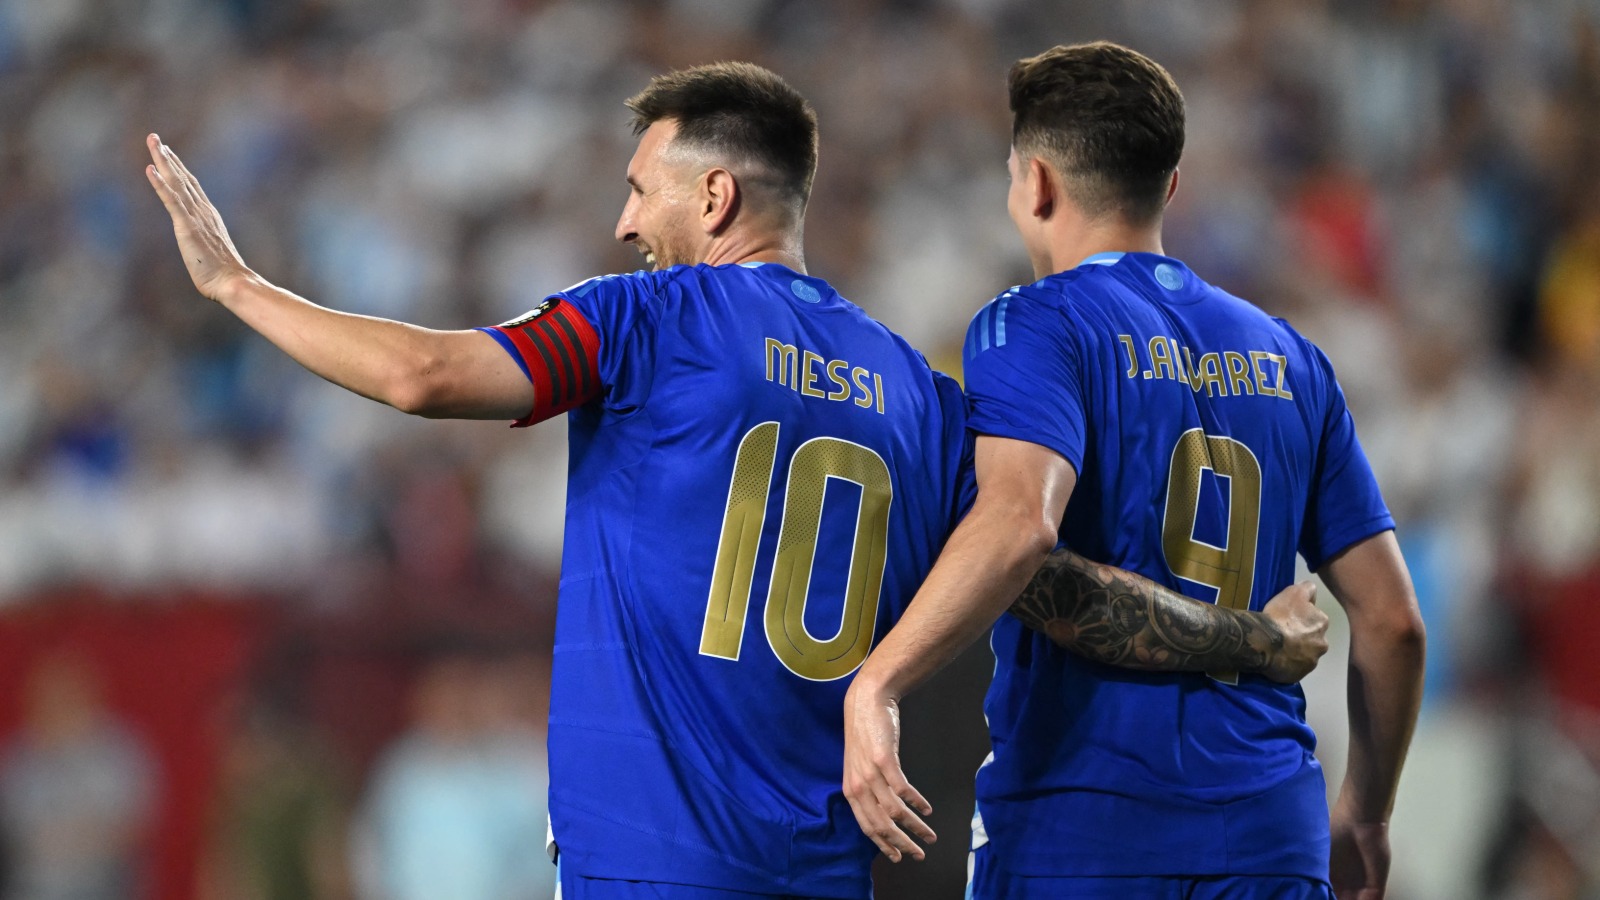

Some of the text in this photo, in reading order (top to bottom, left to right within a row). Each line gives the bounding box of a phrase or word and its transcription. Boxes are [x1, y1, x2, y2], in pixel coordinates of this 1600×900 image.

[765, 337, 884, 414] MESSI
[1118, 334, 1293, 400] J.ALVAREZ
[699, 421, 893, 681] 10
[1162, 427, 1261, 685] 9
